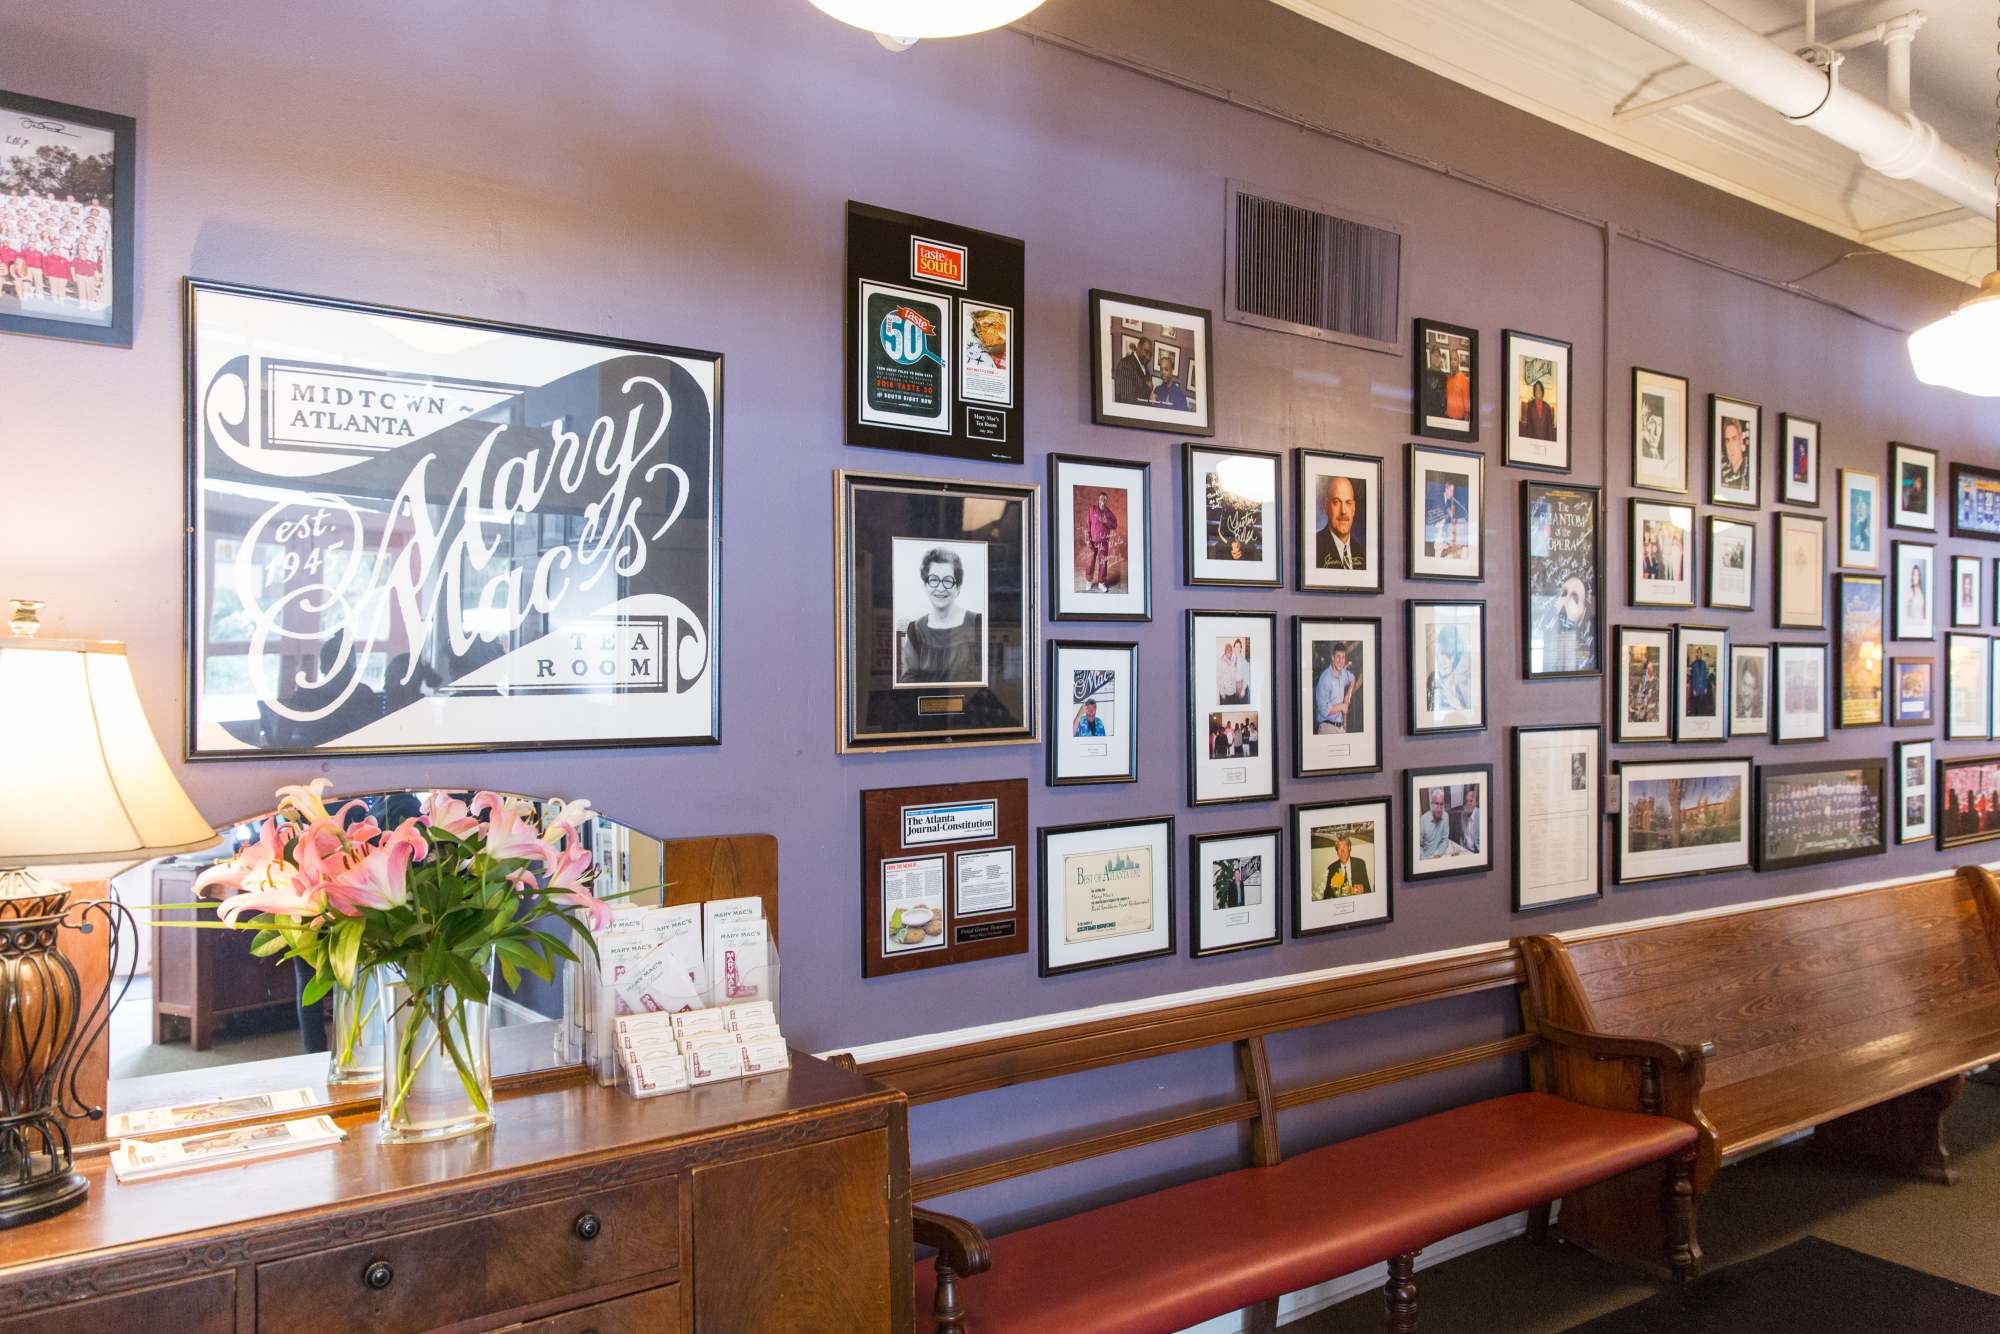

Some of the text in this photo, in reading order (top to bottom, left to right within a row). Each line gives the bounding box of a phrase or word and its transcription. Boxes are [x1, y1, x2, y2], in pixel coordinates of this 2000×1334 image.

[920, 246, 945, 261] taste
[904, 310, 928, 330] taste
[885, 313, 923, 361] 50
[291, 383, 445, 415] MIDTOWN
[290, 409, 415, 437] ATLANTA
[275, 508, 336, 543] est.
[570, 632, 649, 651] TEA
[536, 658, 651, 678] ROOM
[907, 813, 955, 826] The Atlanta
[907, 820, 992, 837] Journal-Constitution
